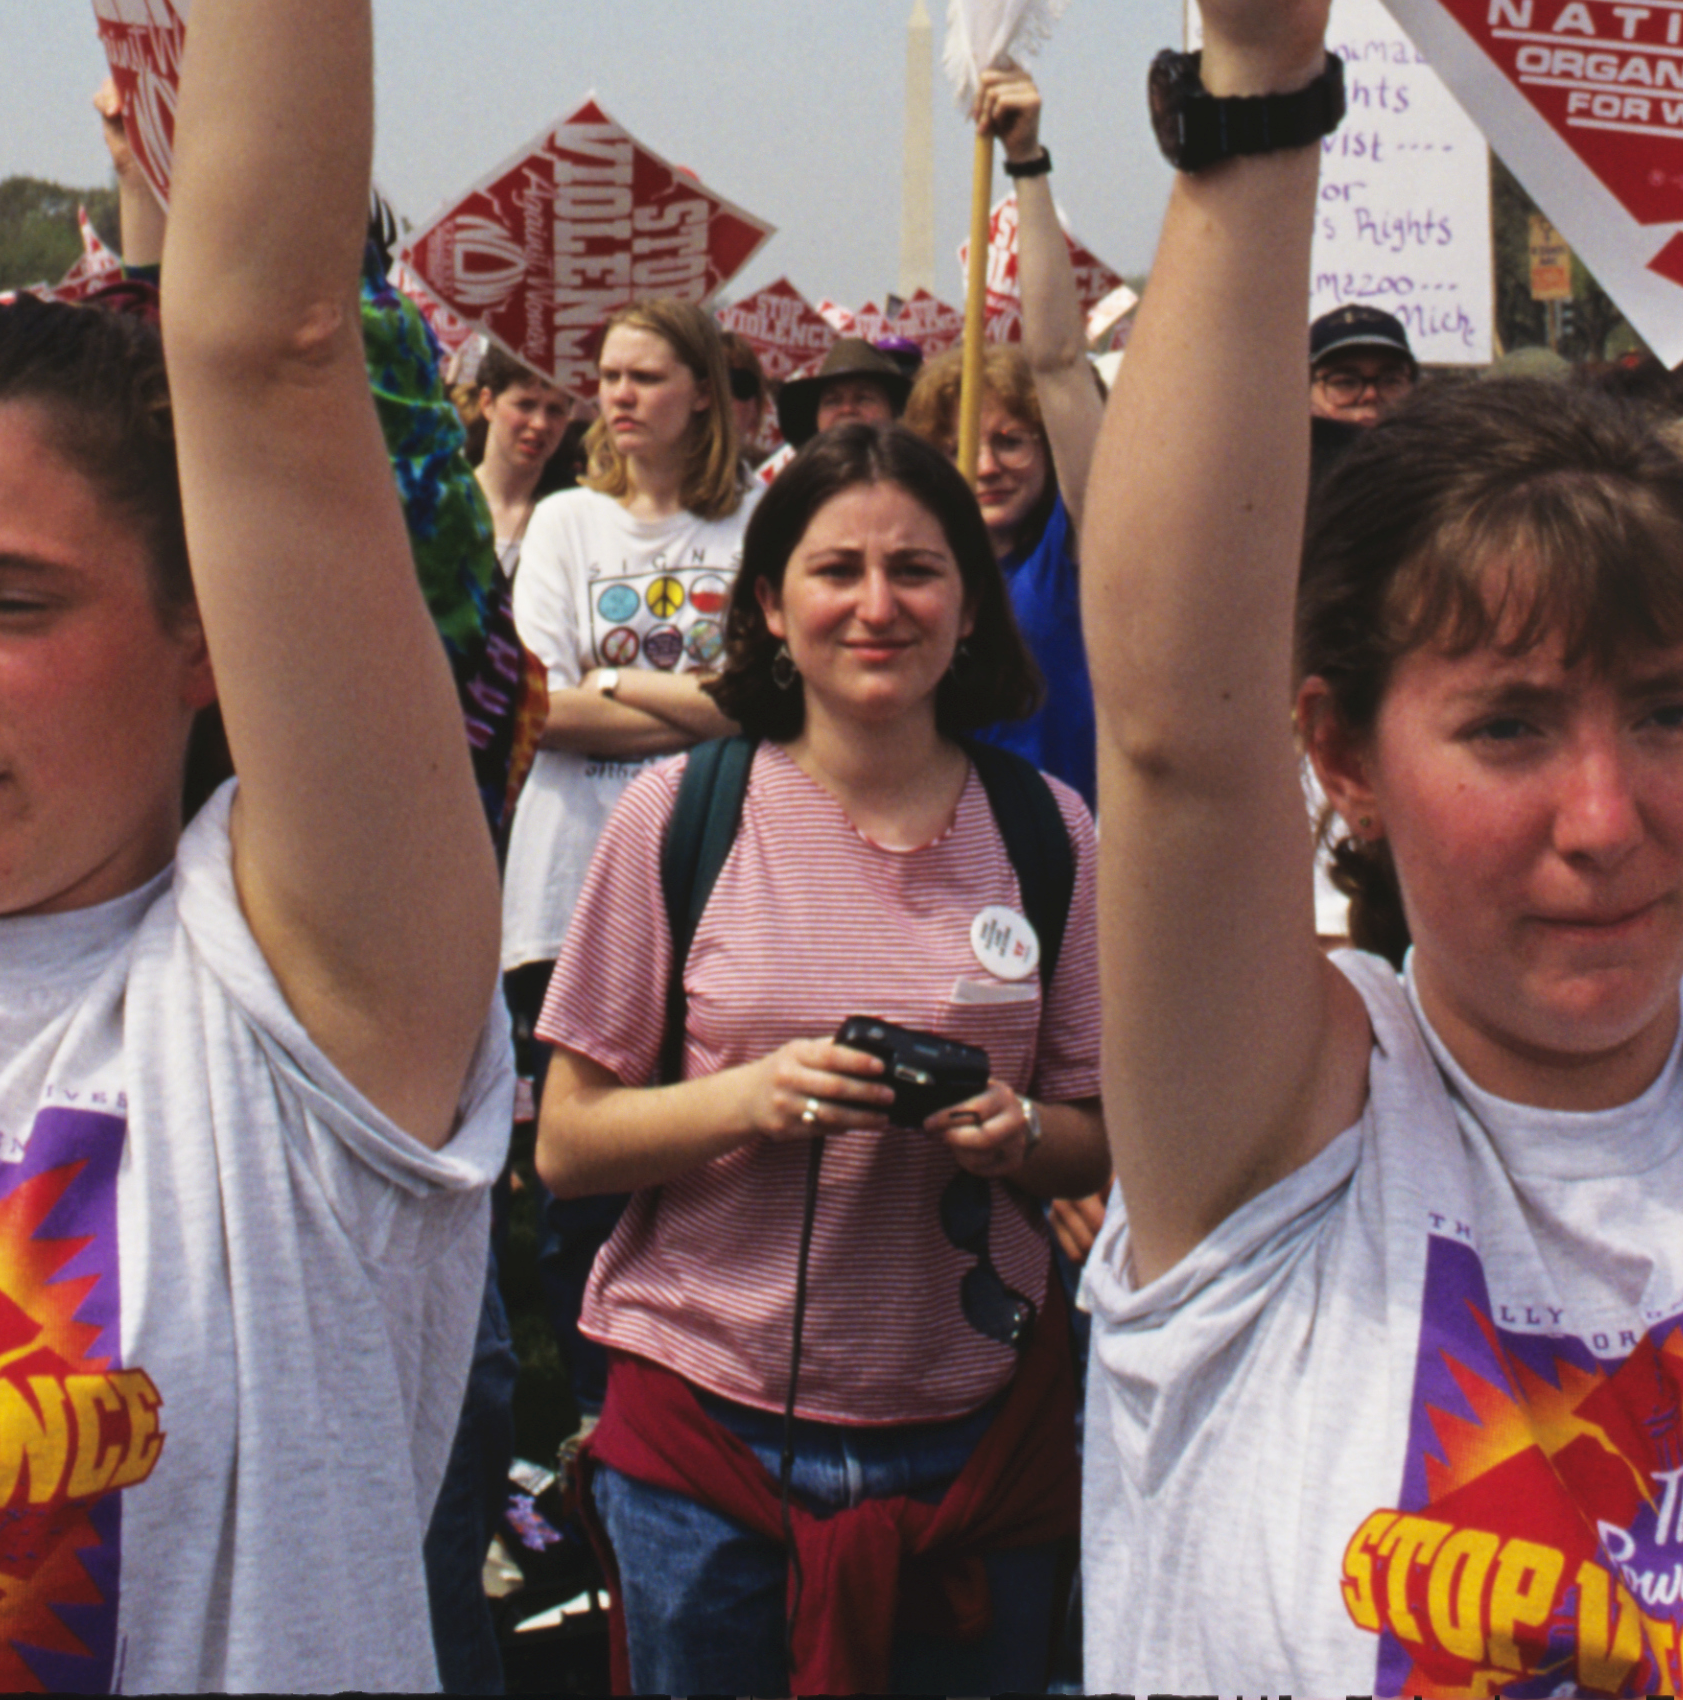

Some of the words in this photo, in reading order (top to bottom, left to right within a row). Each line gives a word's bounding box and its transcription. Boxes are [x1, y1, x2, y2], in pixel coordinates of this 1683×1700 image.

[1566, 89, 1656, 124] FOR
[454, 214, 529, 306] NOW
[722, 306, 839, 348] VIOLENCE
[1341, 1509, 1566, 1676] STOP
